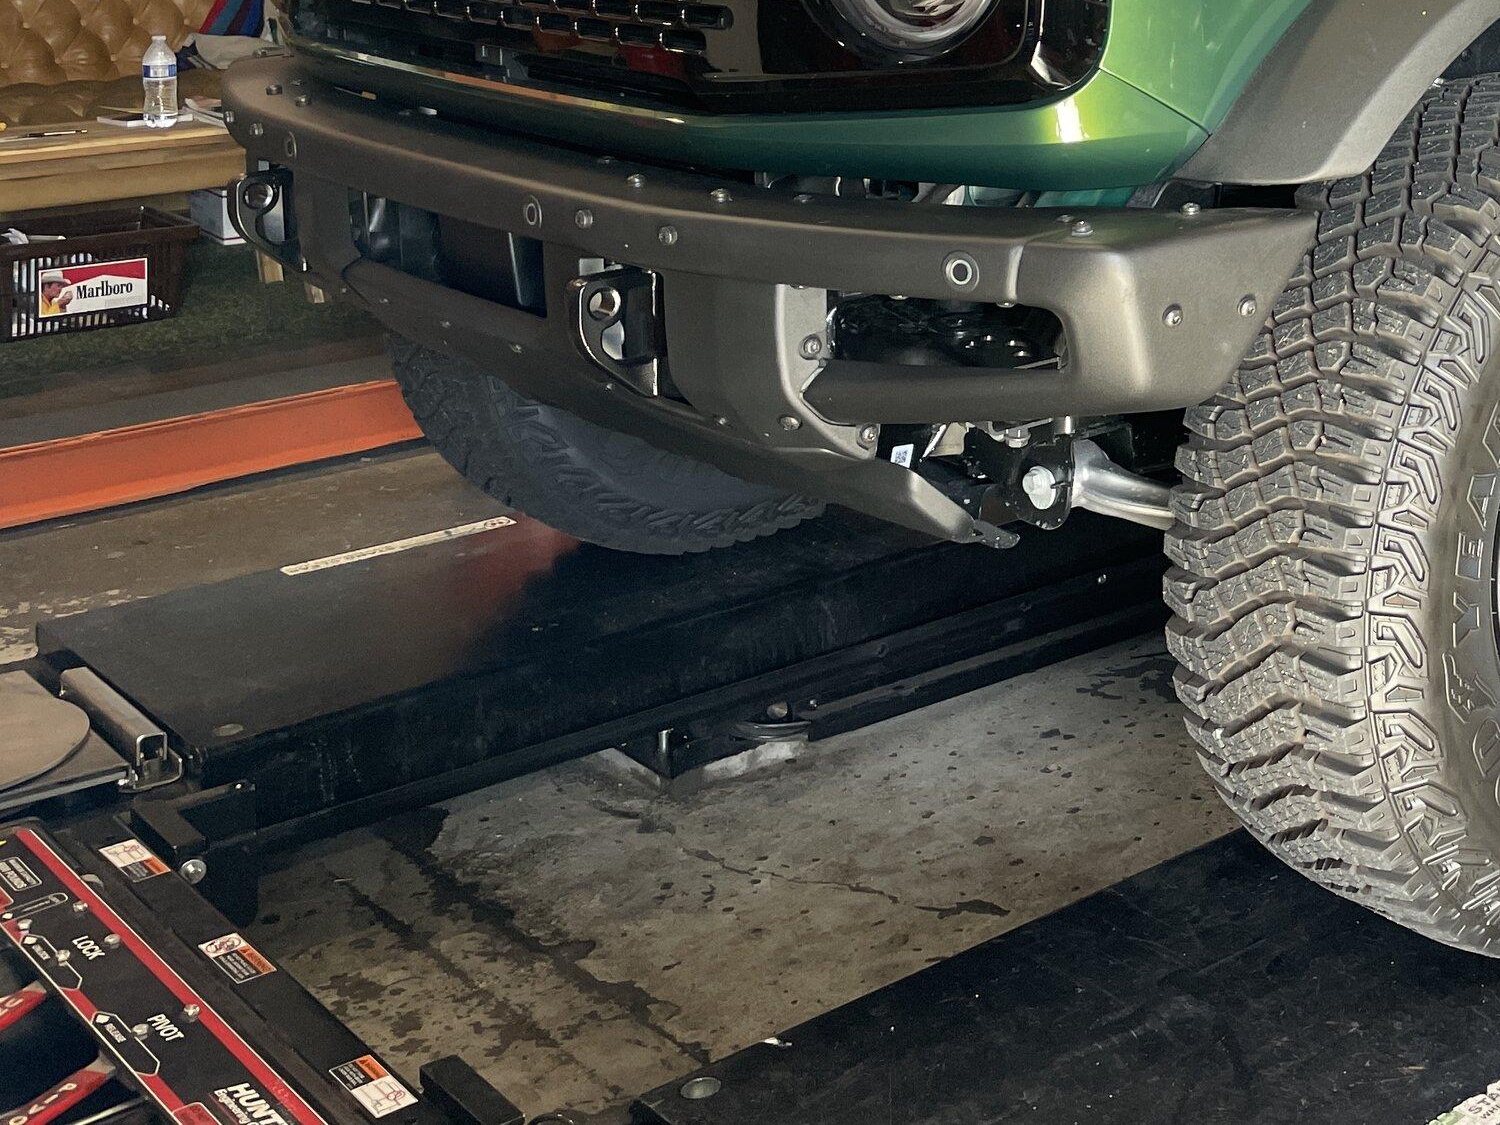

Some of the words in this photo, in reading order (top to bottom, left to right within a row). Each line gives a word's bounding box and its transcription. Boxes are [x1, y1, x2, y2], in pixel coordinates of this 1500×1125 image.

[76, 280, 133, 300] Marlboro
[72, 936, 106, 961] LOCK
[146, 1013, 185, 1042] PIVOT
